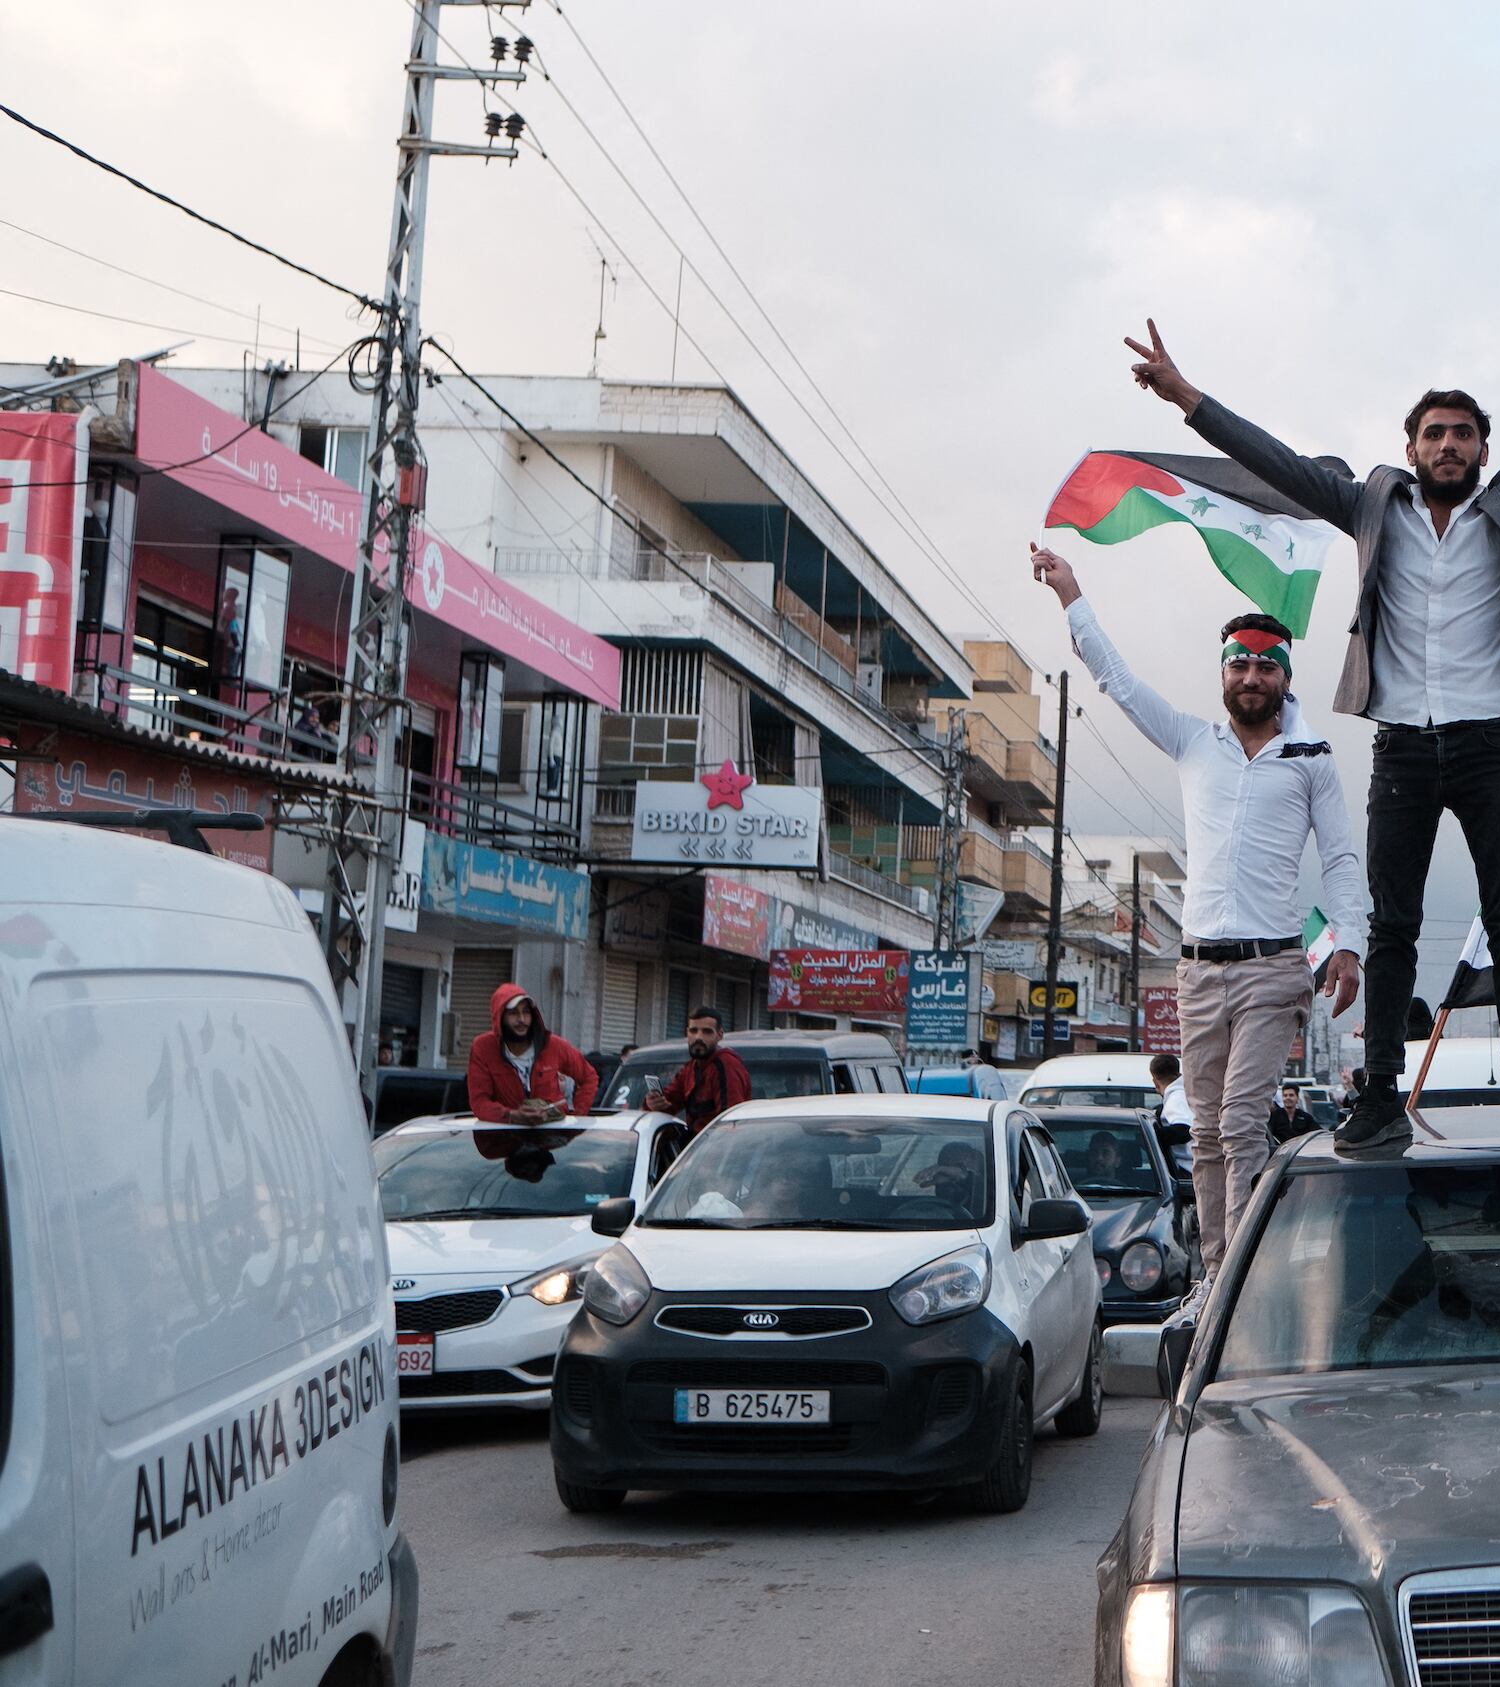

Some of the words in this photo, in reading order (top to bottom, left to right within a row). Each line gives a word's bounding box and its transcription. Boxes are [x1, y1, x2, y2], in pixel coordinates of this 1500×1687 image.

[263, 462, 278, 490] 19
[321, 500, 346, 534] يوم
[641, 810, 727, 835] BBKID
[736, 815, 808, 838] STAR
[801, 952, 847, 971] الحديث
[848, 954, 886, 972] المنزل
[914, 953, 967, 977] شركة
[912, 979, 966, 1000] فارس
[614, 1085, 630, 1105] 2
[750, 1314, 773, 1325] KIA
[399, 1350, 432, 1371] 692
[696, 1394, 710, 1418] B
[726, 1393, 813, 1418] 625475
[131, 1397, 291, 1557] ALANAKA
[294, 1338, 385, 1458] 3DESIGN
[322, 1584, 357, 1634] Main
[360, 1550, 385, 1605] Road
